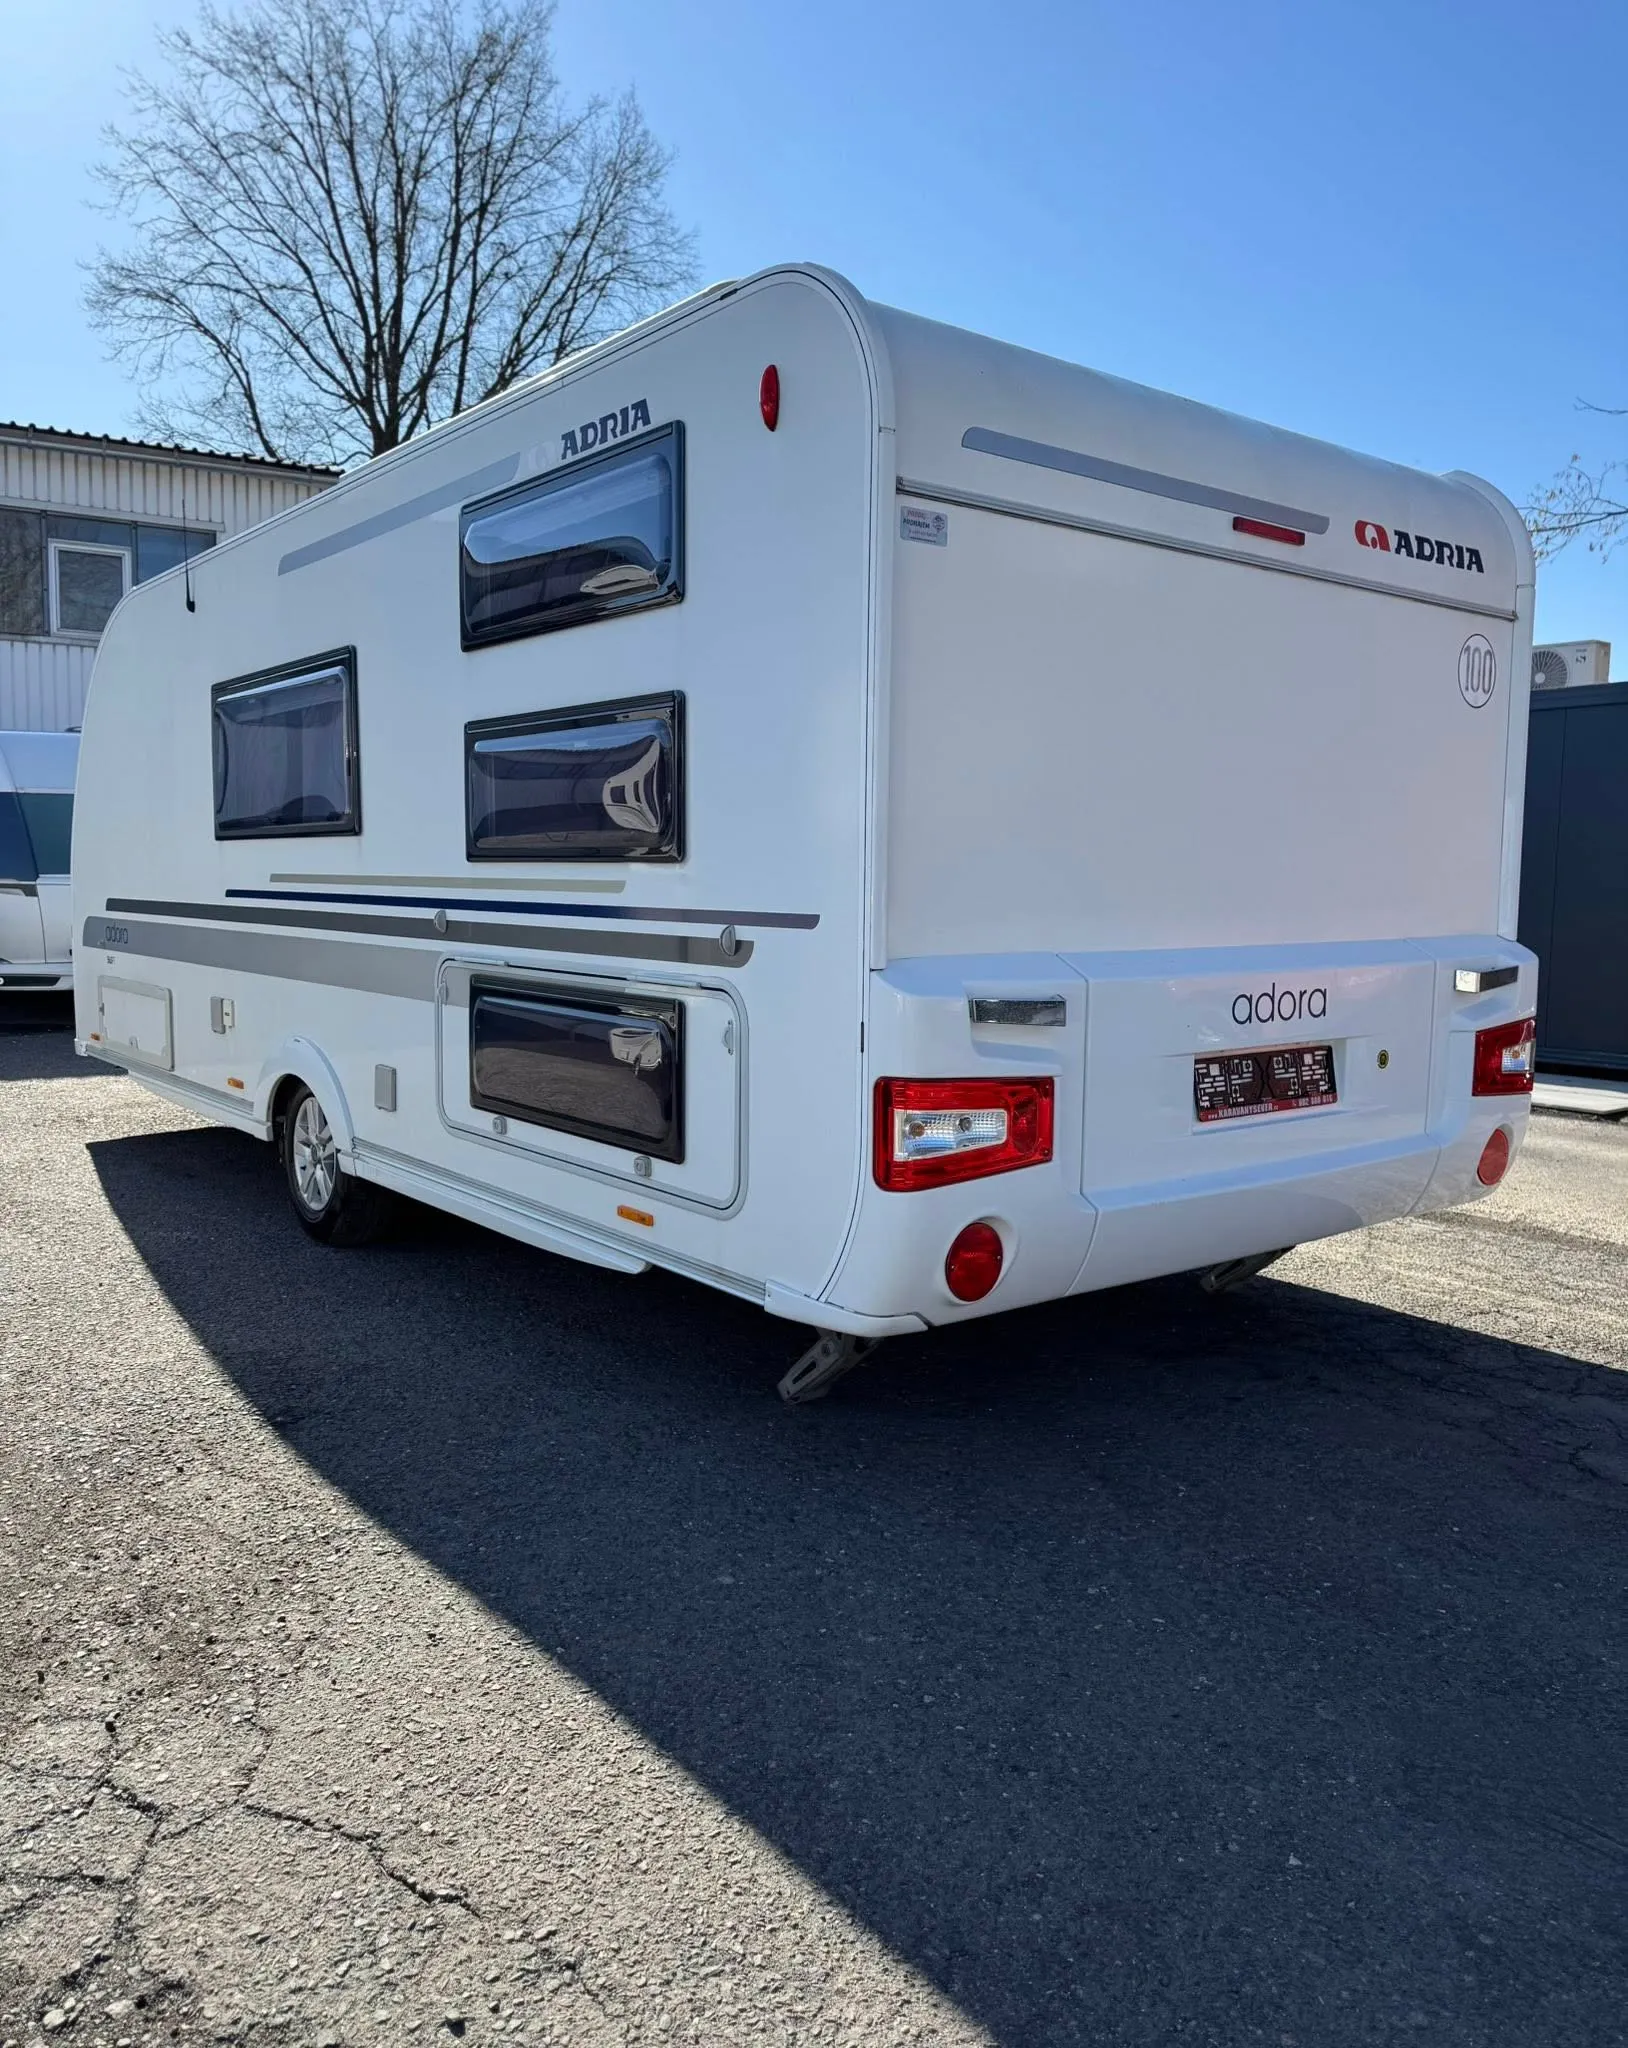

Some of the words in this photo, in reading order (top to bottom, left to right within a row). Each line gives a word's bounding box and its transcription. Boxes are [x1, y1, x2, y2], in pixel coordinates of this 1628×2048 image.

[561, 398, 651, 460] ADRIA
[1394, 529, 1484, 573] ADRIA
[1464, 645, 1493, 694] 100
[106, 920, 128, 944] adora
[1232, 982, 1327, 1025] adora
